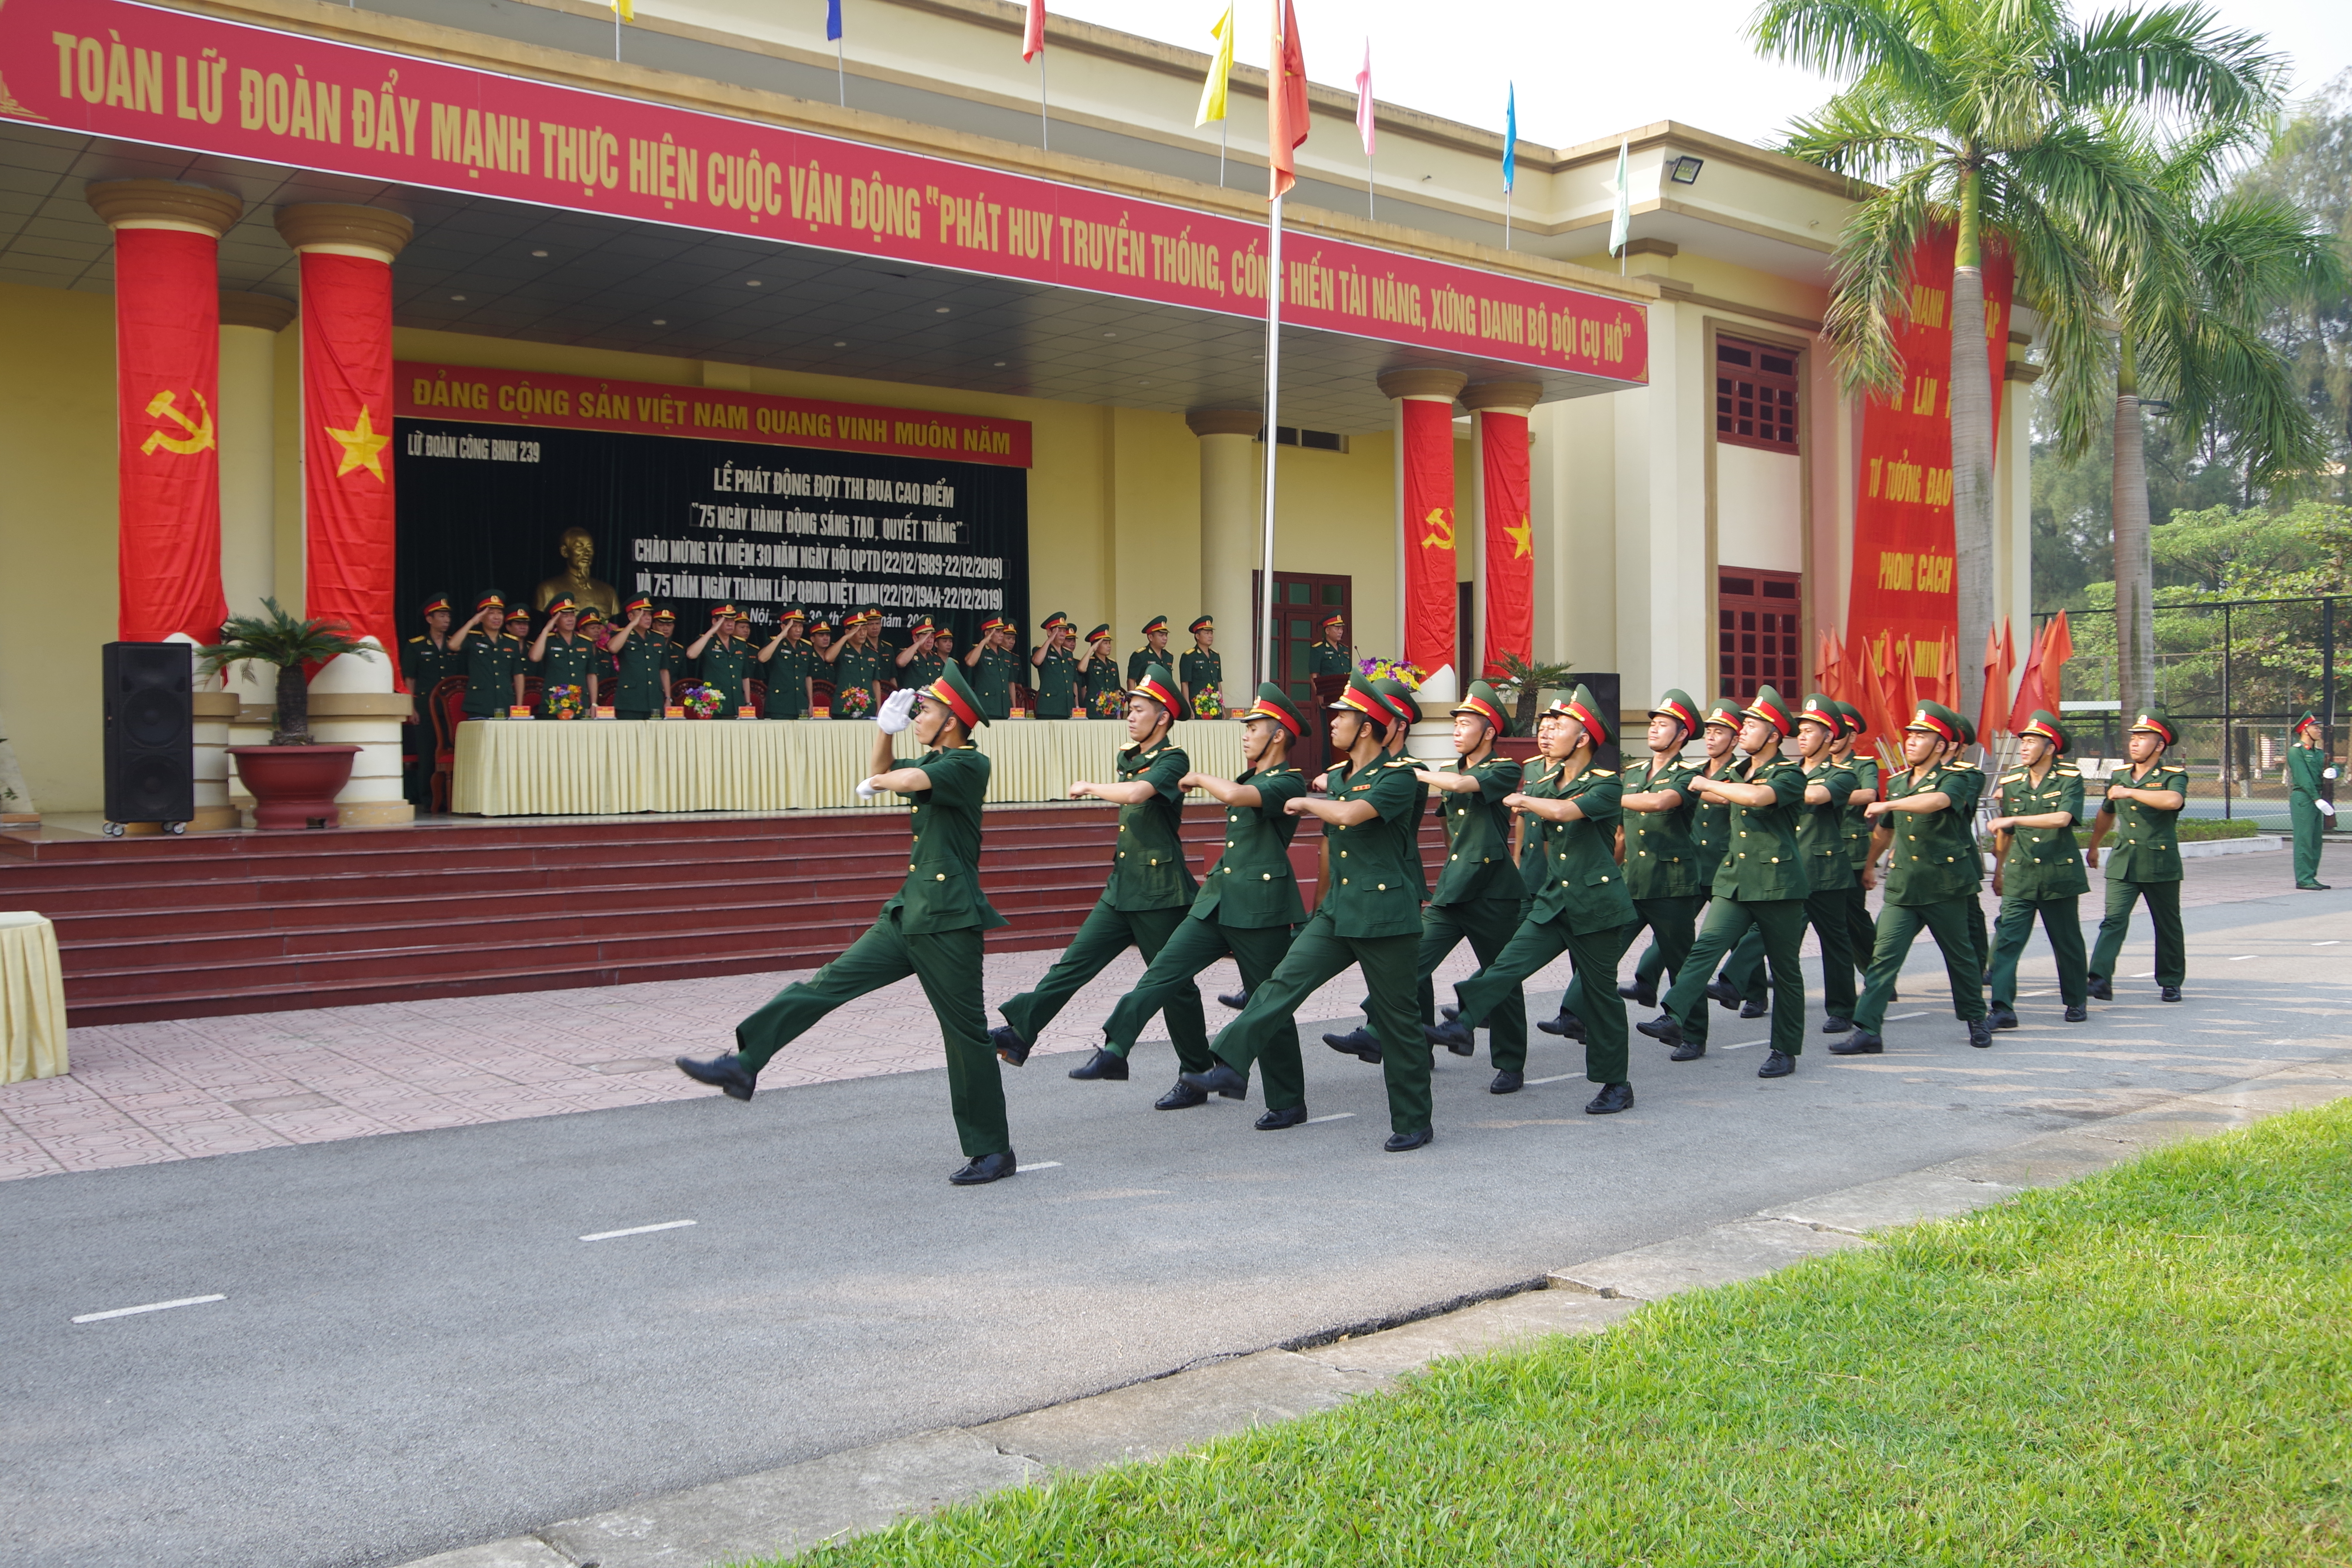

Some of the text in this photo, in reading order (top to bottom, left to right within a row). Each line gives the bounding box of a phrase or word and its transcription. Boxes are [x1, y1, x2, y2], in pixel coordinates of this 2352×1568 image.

[52, 29, 163, 115] TOÀN
[176, 48, 227, 124] LỮ
[239, 64, 341, 144] ĐOÀN
[352, 68, 420, 156] ĐẨY
[431, 101, 530, 178] MẠNH
[539, 122, 619, 196] THỰC
[629, 132, 698, 210] HIỆN
[707, 148, 782, 224] CUỘC
[789, 159, 842, 232] VẬN
[850, 171, 921, 242] ĐỘNG
[1008, 206, 1053, 261] HUY
[1060, 211, 1145, 278] TRUYỀN
[1151, 225, 1225, 298] THỐNG,
[1290, 251, 1334, 312] HIẾN
[1339, 264, 1367, 318] TÀI
[1372, 272, 1427, 333] NĂNG,
[1431, 283, 1476, 337] XỨNG
[1480, 297, 1523, 344] DANH
[1527, 302, 1547, 356] BỘ
[1551, 307, 1577, 361] ĐỘI
[1580, 317, 1600, 365] CỤ
[412, 369, 1010, 455] ĐẢNG CỘNG SẢN VIỆT NAM QUANG VINH MUÔN NĂM
[407, 430, 540, 463] LỮ ĐOÀN CÔNG BINH 239
[714, 459, 954, 508] LỄ PHÁT ĐỘNG ĐỢT THI ĐUA CAO ĐIỂM
[1869, 455, 1883, 498] TƯ
[1925, 467, 1953, 513] ĐẠO
[717, 503, 748, 530] NGÀY
[751, 504, 782, 533] HÀNH
[786, 507, 817, 537] ĐỘNG
[820, 510, 849, 537] SÁNG
[852, 515, 879, 542] TẠO,
[882, 512, 919, 542] QUYẾT
[634, 535, 668, 563] CHÀO
[670, 536, 706, 564] MỪNG
[708, 534, 724, 565] KỶ
[726, 538, 755, 569] NIỆM
[756, 543, 772, 567] 30
[773, 540, 797, 568] NĂM
[800, 542, 830, 570] NGÀY
[832, 544, 851, 573] HỘI
[851, 548, 880, 573] QPTD
[1917, 545, 1952, 594] CÁCH
[636, 568, 651, 596] VÀ
[653, 573, 671, 597] 75
[672, 570, 698, 598] NĂM
[701, 572, 731, 599] NGÀY
[733, 573, 772, 601] THÀNH
[774, 575, 796, 606] LẬP
[797, 581, 828, 604] QĐND
[830, 578, 855, 608] VIỆT
[856, 583, 879, 605] NAM
[750, 607, 772, 626] Nội,
[881, 613, 901, 628] năm
